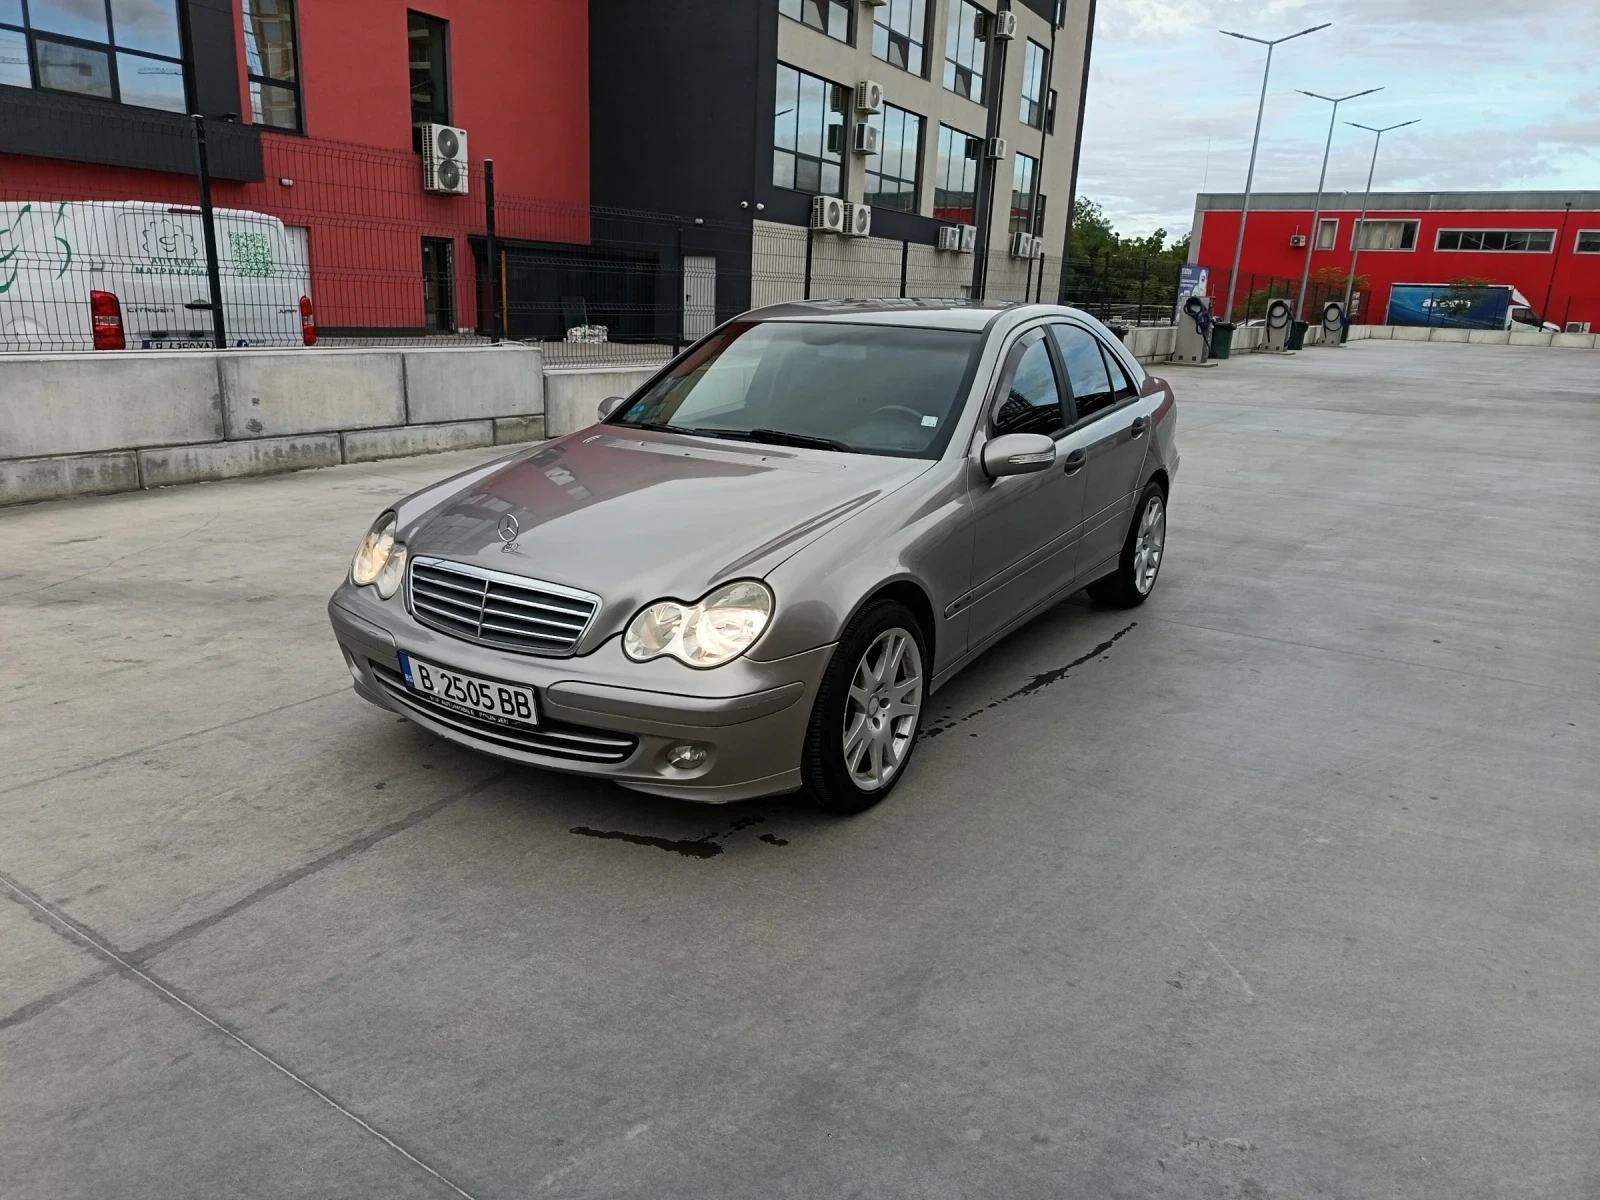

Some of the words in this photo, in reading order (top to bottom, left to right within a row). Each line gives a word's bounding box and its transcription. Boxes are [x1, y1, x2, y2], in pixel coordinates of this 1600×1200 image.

[151, 257, 195, 267] АПТЕКИ
[418, 664, 434, 691] B
[440, 673, 495, 710] 2505
[498, 687, 532, 719] BB
